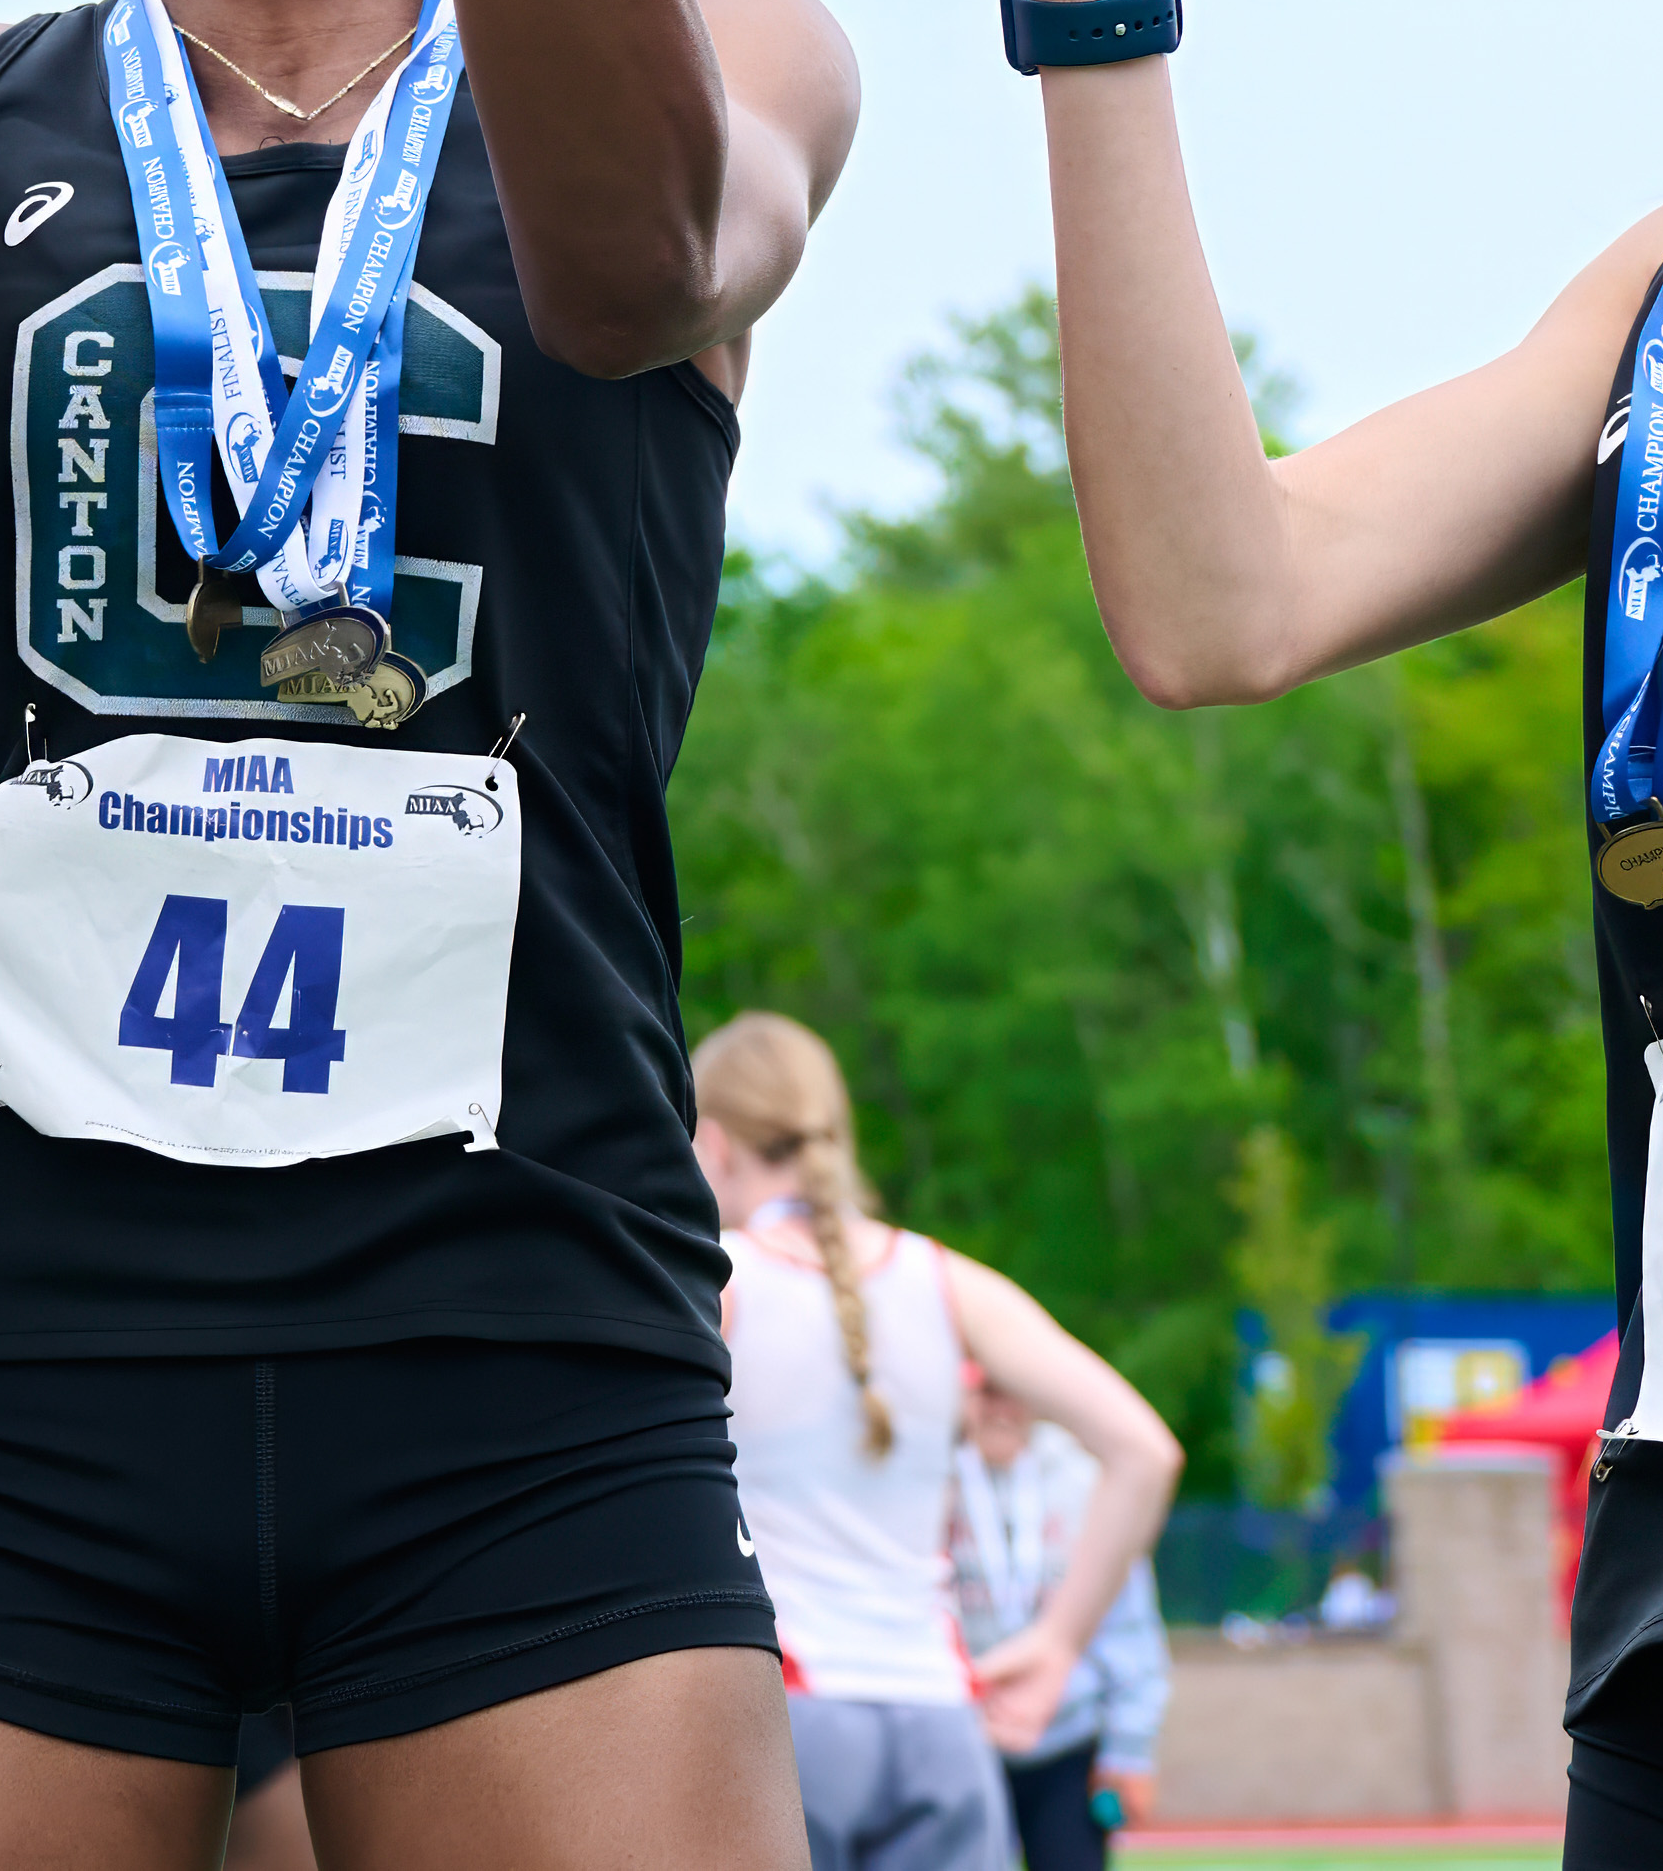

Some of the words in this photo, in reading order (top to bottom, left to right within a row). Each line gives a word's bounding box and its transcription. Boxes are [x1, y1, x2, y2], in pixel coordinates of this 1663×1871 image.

[341, 230, 394, 335] CHAMPION
[56, 330, 114, 644] CANTON
[177, 460, 206, 555] AMPION
[262, 418, 322, 541] CHAMPION
[263, 640, 326, 677] MIAA
[98, 790, 394, 850] Championships
[202, 755, 294, 795] MIAA
[408, 797, 457, 815] MIAA
[118, 893, 347, 1095] 44
